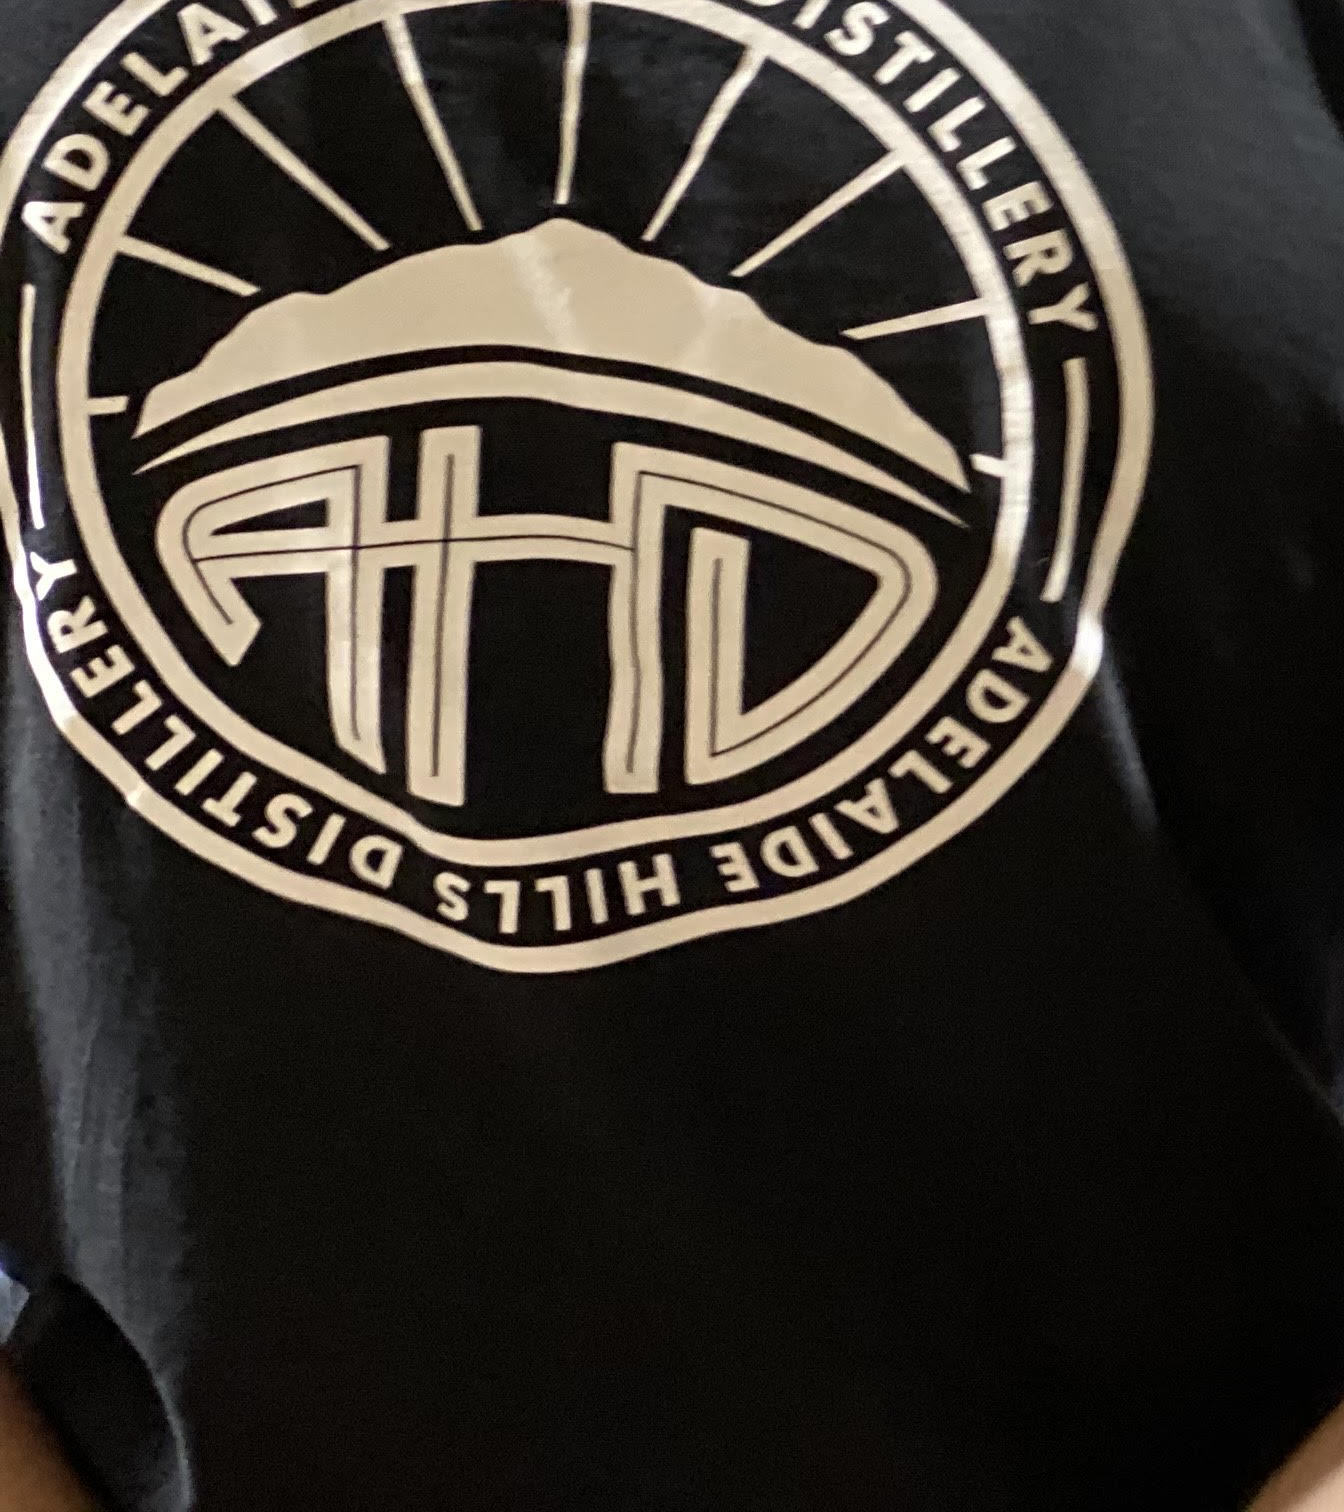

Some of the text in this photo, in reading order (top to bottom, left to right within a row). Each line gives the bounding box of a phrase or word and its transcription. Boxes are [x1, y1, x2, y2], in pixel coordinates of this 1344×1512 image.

[28, 550, 1053, 935] ADELAIDE HILLS DISTILLERY
[155, 424, 939, 808] AHD
